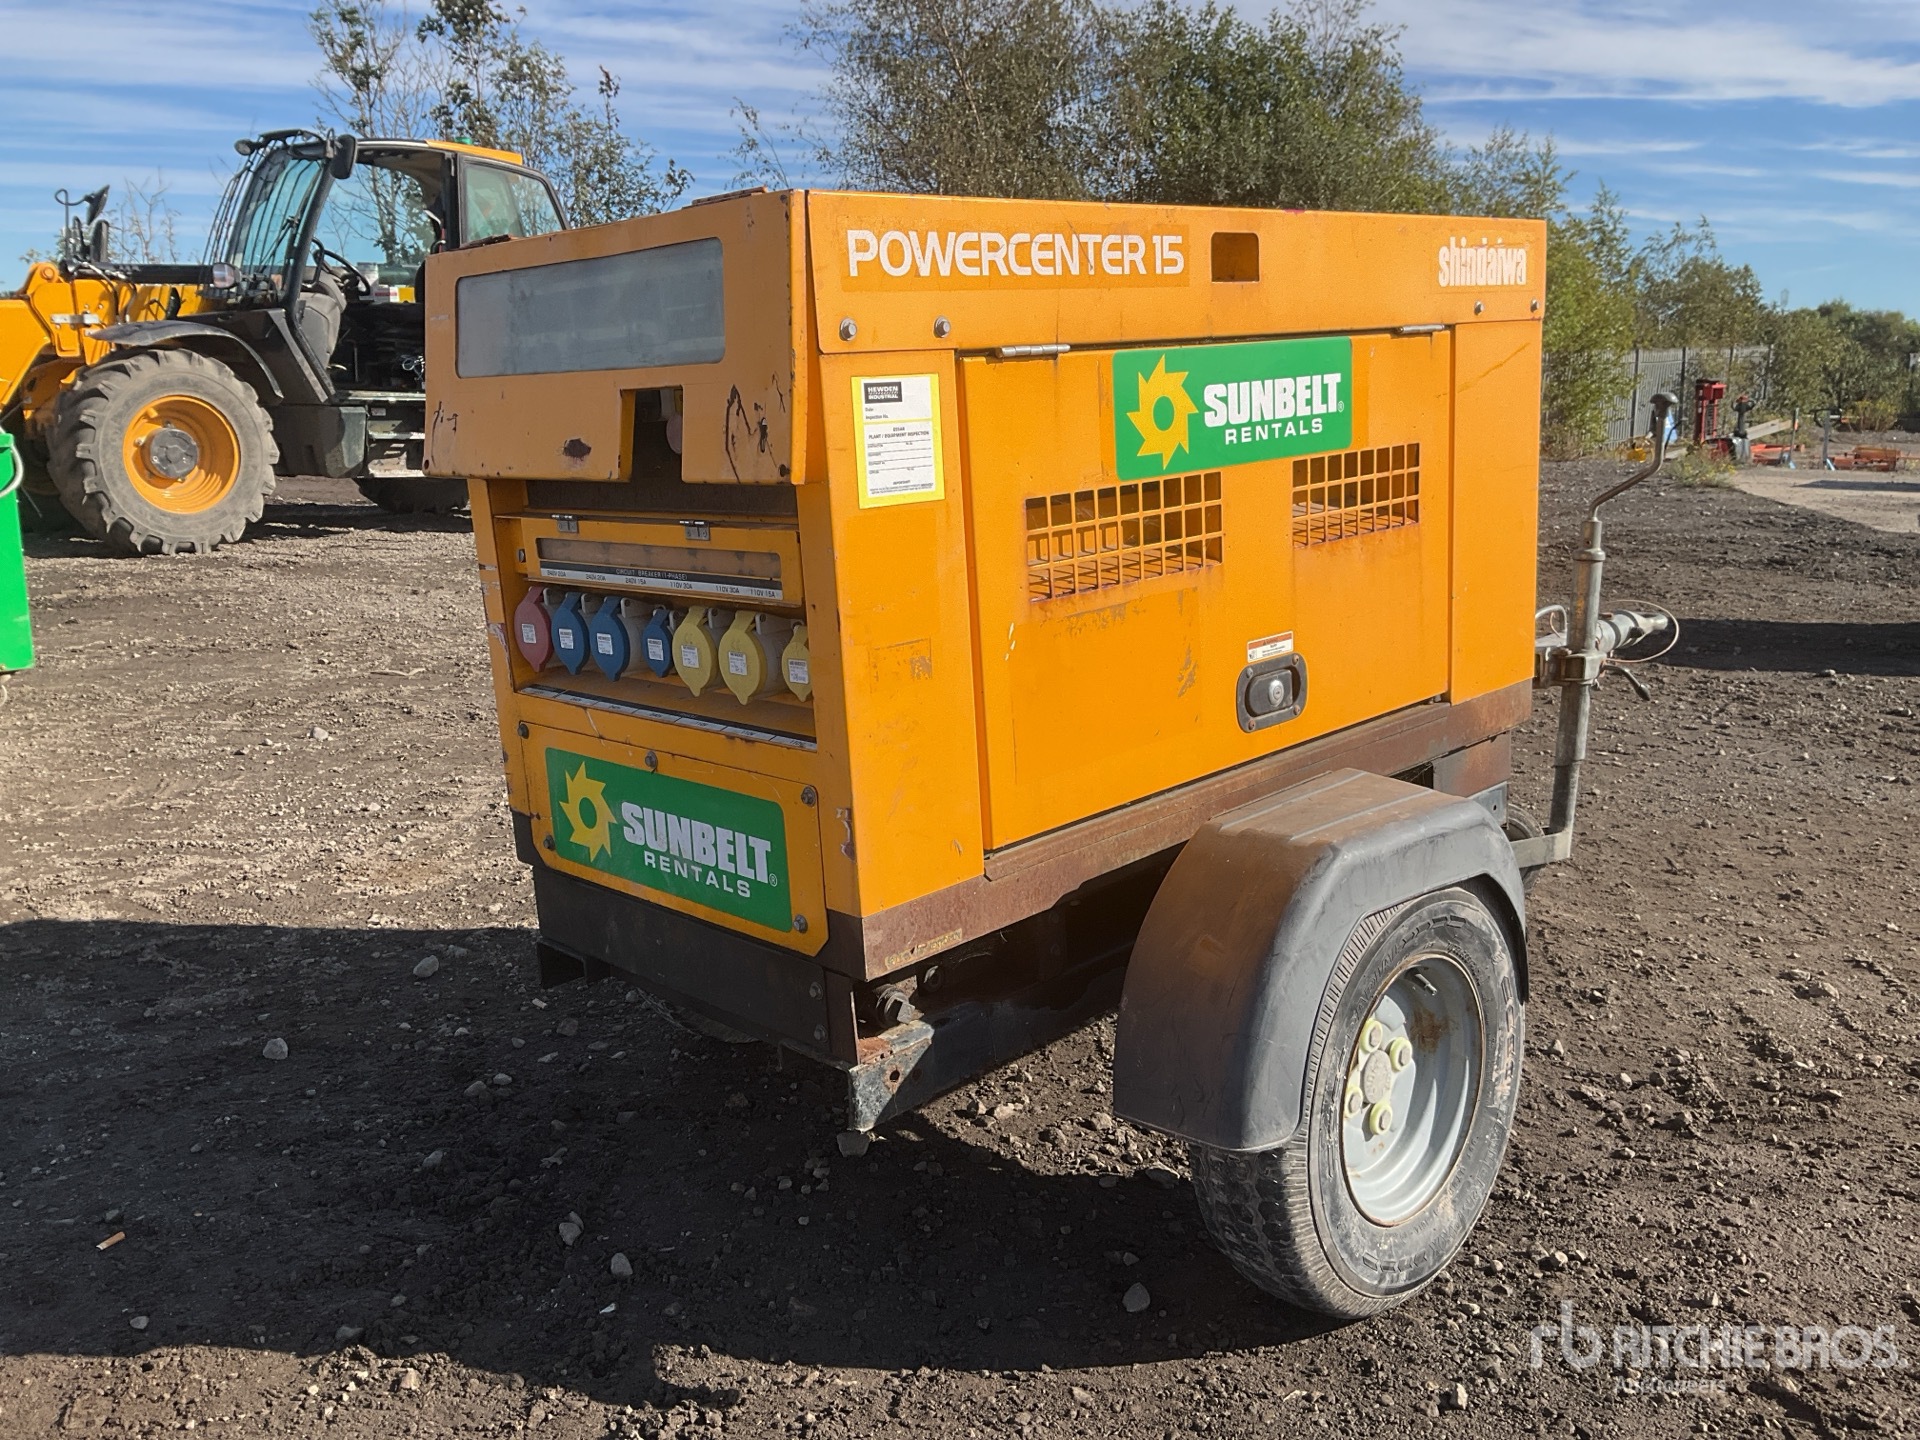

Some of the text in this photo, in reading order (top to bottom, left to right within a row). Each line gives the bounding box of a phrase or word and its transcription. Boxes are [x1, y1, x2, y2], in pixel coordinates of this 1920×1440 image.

[847, 229, 1185, 277] POWERCENTER 15
[1204, 373, 1342, 428] SUNBELT
[1225, 418, 1323, 445] RENTALS
[615, 568, 635, 576] CIRCUIT
[621, 801, 772, 884] SUNBELT
[643, 850, 751, 898] RENTALS
